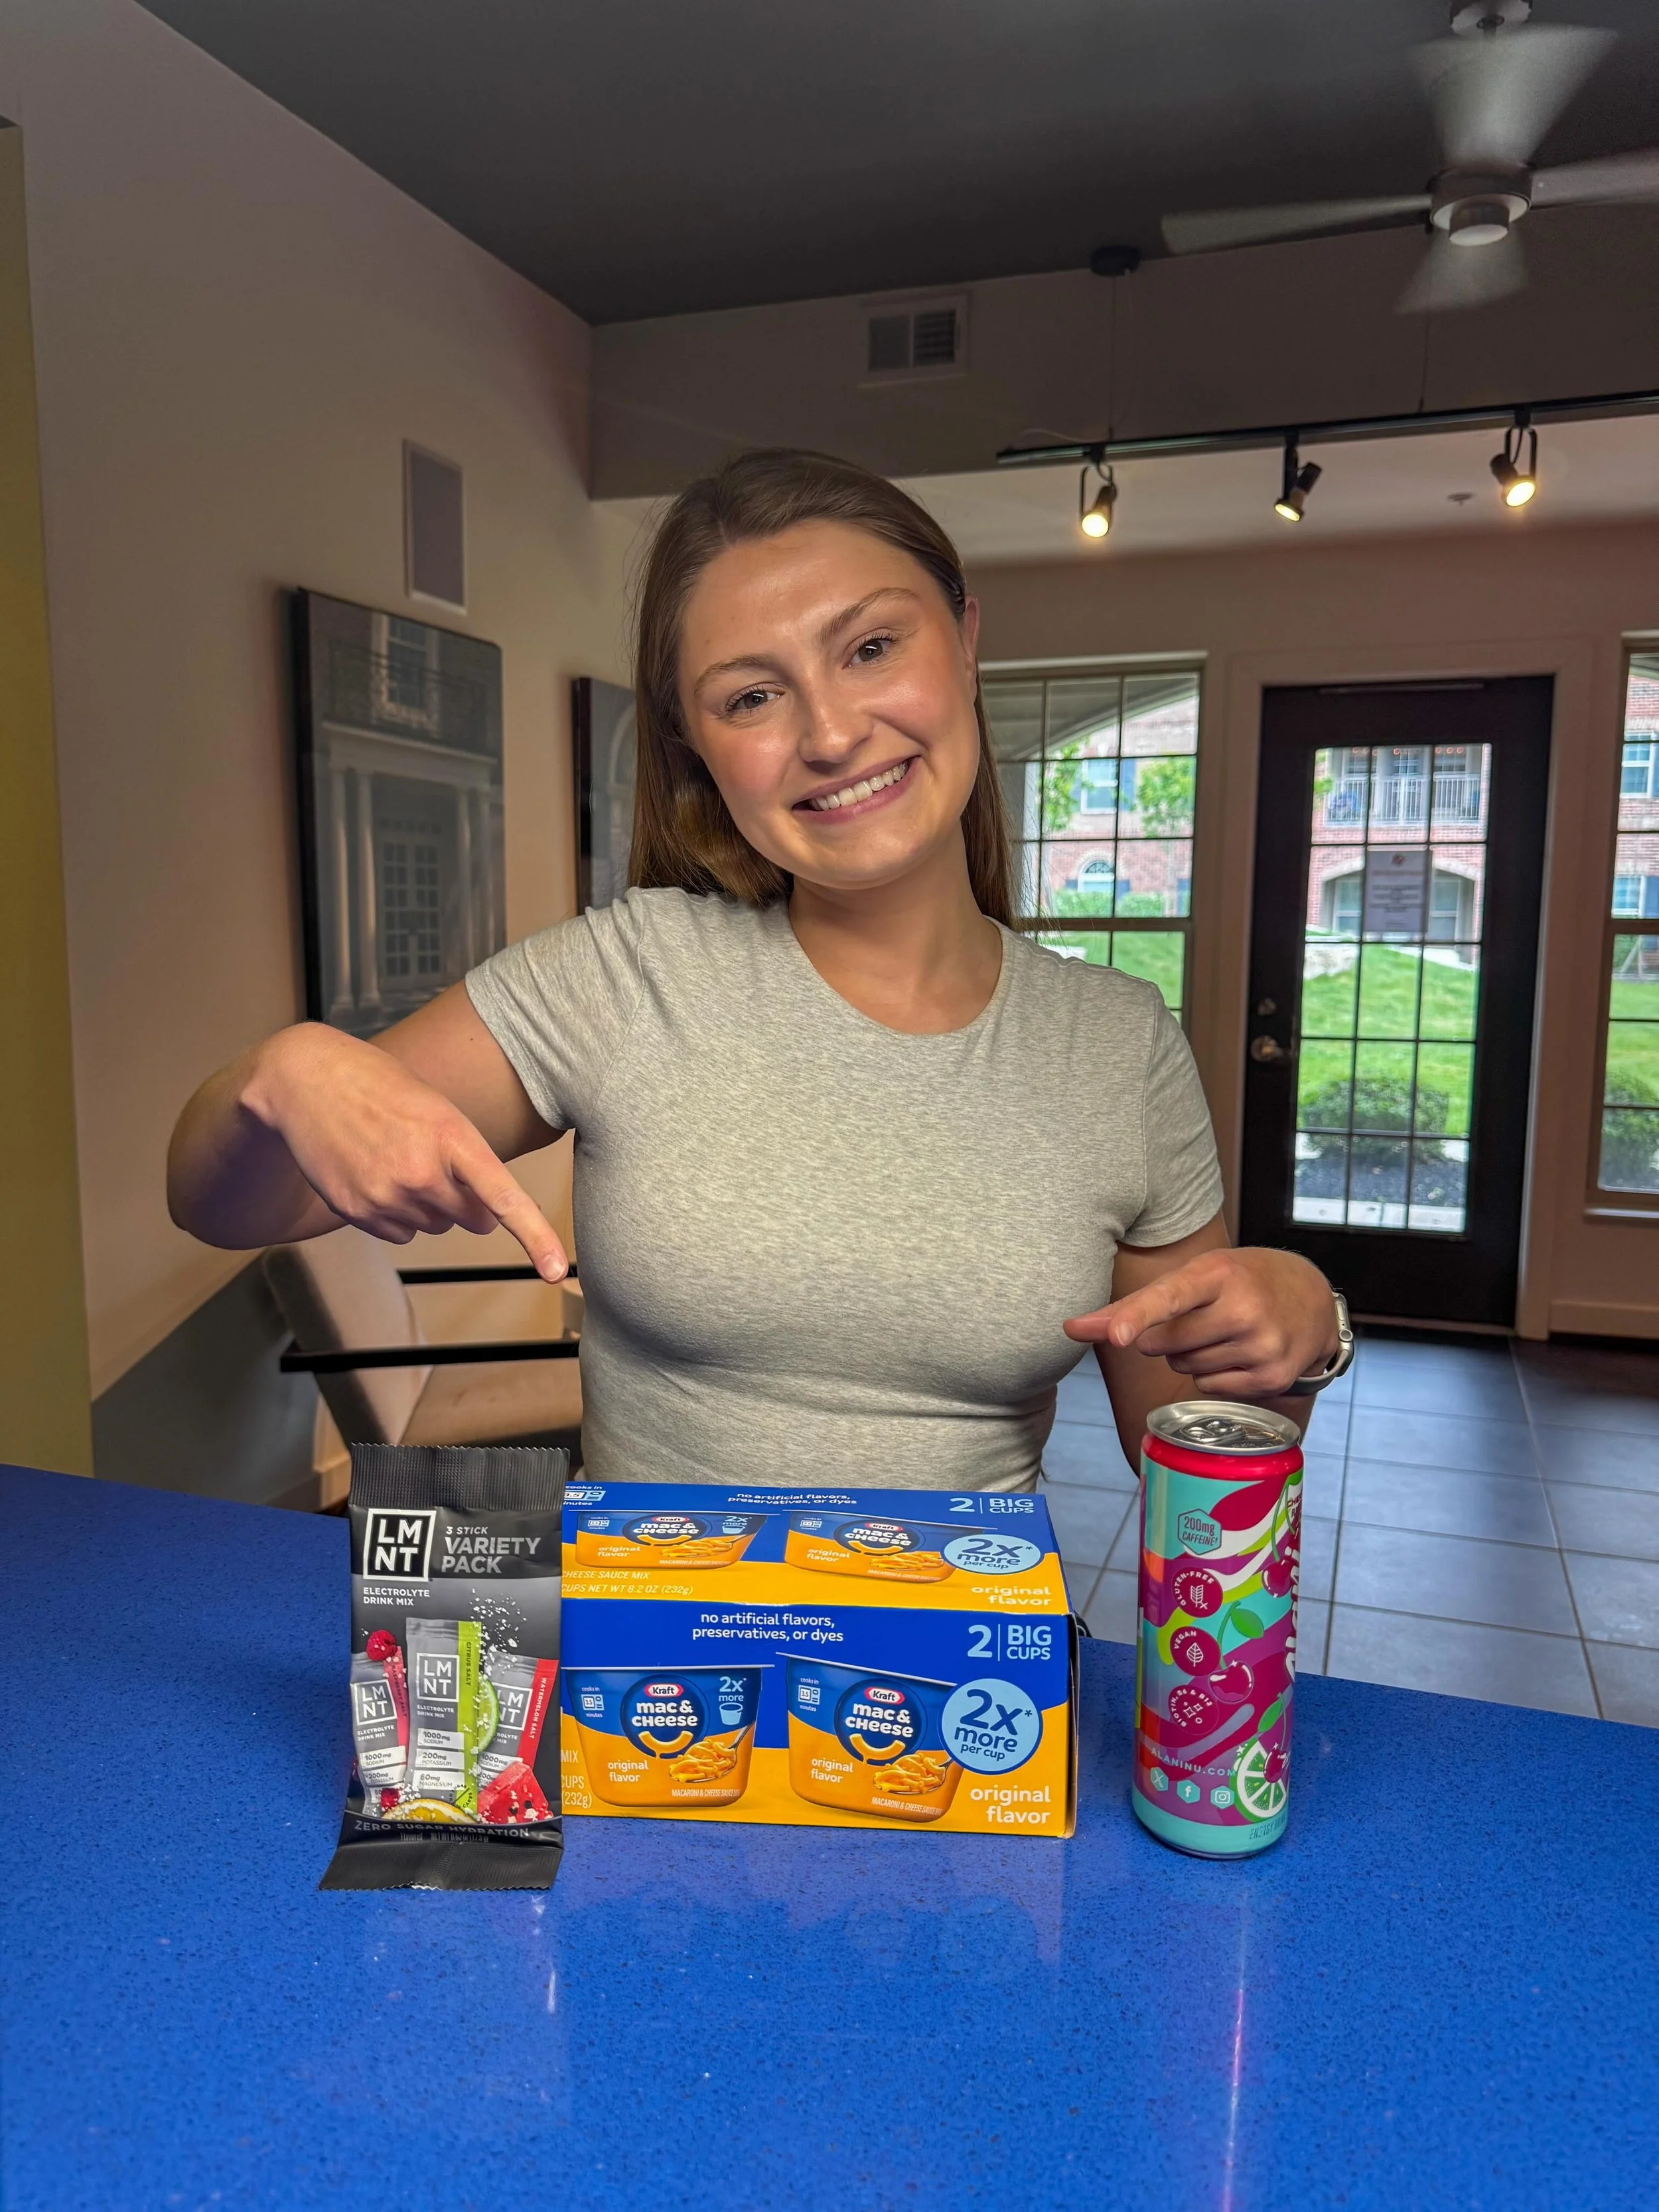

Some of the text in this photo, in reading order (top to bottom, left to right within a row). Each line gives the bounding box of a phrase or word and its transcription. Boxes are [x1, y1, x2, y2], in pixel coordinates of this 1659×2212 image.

[949, 1497, 1034, 1513] 2 BIG
[378, 1518, 423, 1545] LM
[446, 1526, 488, 1535] 3 STICK
[853, 1528, 894, 1538] mac
[1184, 1516, 1215, 1536] 200mg
[444, 1536, 541, 1555] VARIETY
[808, 1548, 850, 1558] original
[374, 1546, 419, 1572] NT
[441, 1556, 504, 1574] PACK
[806, 1554, 839, 1562] flavor
[957, 1553, 1021, 1566] more
[598, 1571, 630, 1580] SAUCE
[363, 1587, 431, 1597] ELECTROLYTE
[589, 1584, 609, 1593] NET
[610, 1585, 627, 1593] WT
[627, 1585, 644, 1593] 8.2
[662, 1585, 693, 1595] (232g)
[971, 1585, 1051, 1595] original
[1174, 1570, 1214, 1606] GLUTEN-FREE
[363, 1597, 415, 1606] DRINK MIX
[987, 1594, 1052, 1605] flavor
[701, 1612, 835, 1629] no artificial flavors,
[692, 1627, 844, 1645] preservatives, or dyes
[967, 1624, 1052, 1659] 2 BIG
[1174, 1631, 1197, 1650] VEGAN
[1006, 1646, 1052, 1660] CUPS
[424, 1660, 451, 1677] LM
[362, 1686, 386, 1702] LM
[424, 1678, 451, 1695] NT
[652, 1686, 676, 1696] Kraft
[718, 1694, 744, 1702] more
[873, 1690, 895, 1702] Kraft
[363, 1700, 388, 1718] NT
[417, 1704, 455, 1713] ELECTROLYTE
[529, 1677, 547, 1739] WATERMELON SALT
[636, 1700, 694, 1714] mac &
[853, 1703, 910, 1724] mac &
[1171, 1696, 1187, 1727] BIOTIN,
[1198, 1693, 1213, 1706] B12
[357, 1725, 395, 1735] ELECTROLYTE
[423, 1732, 451, 1741] 1000mg
[954, 1726, 1018, 1753] more
[423, 1752, 447, 1761] 200mg
[561, 1749, 579, 1763] MIX
[960, 1743, 1006, 1762] per cup
[607, 1759, 649, 1773] original
[812, 1758, 853, 1773] original
[1151, 1747, 1236, 1776] ALANINU.COM
[609, 1771, 641, 1783] flavor
[810, 1768, 843, 1783] flavor
[562, 1791, 593, 1809] (232g)
[871, 1797, 901, 1808] MACARONI
[970, 1785, 1051, 1806] original
[986, 1805, 1051, 1824] flavor
[354, 1820, 392, 1830] ZERO
[449, 1825, 530, 1838] HYDRATION
